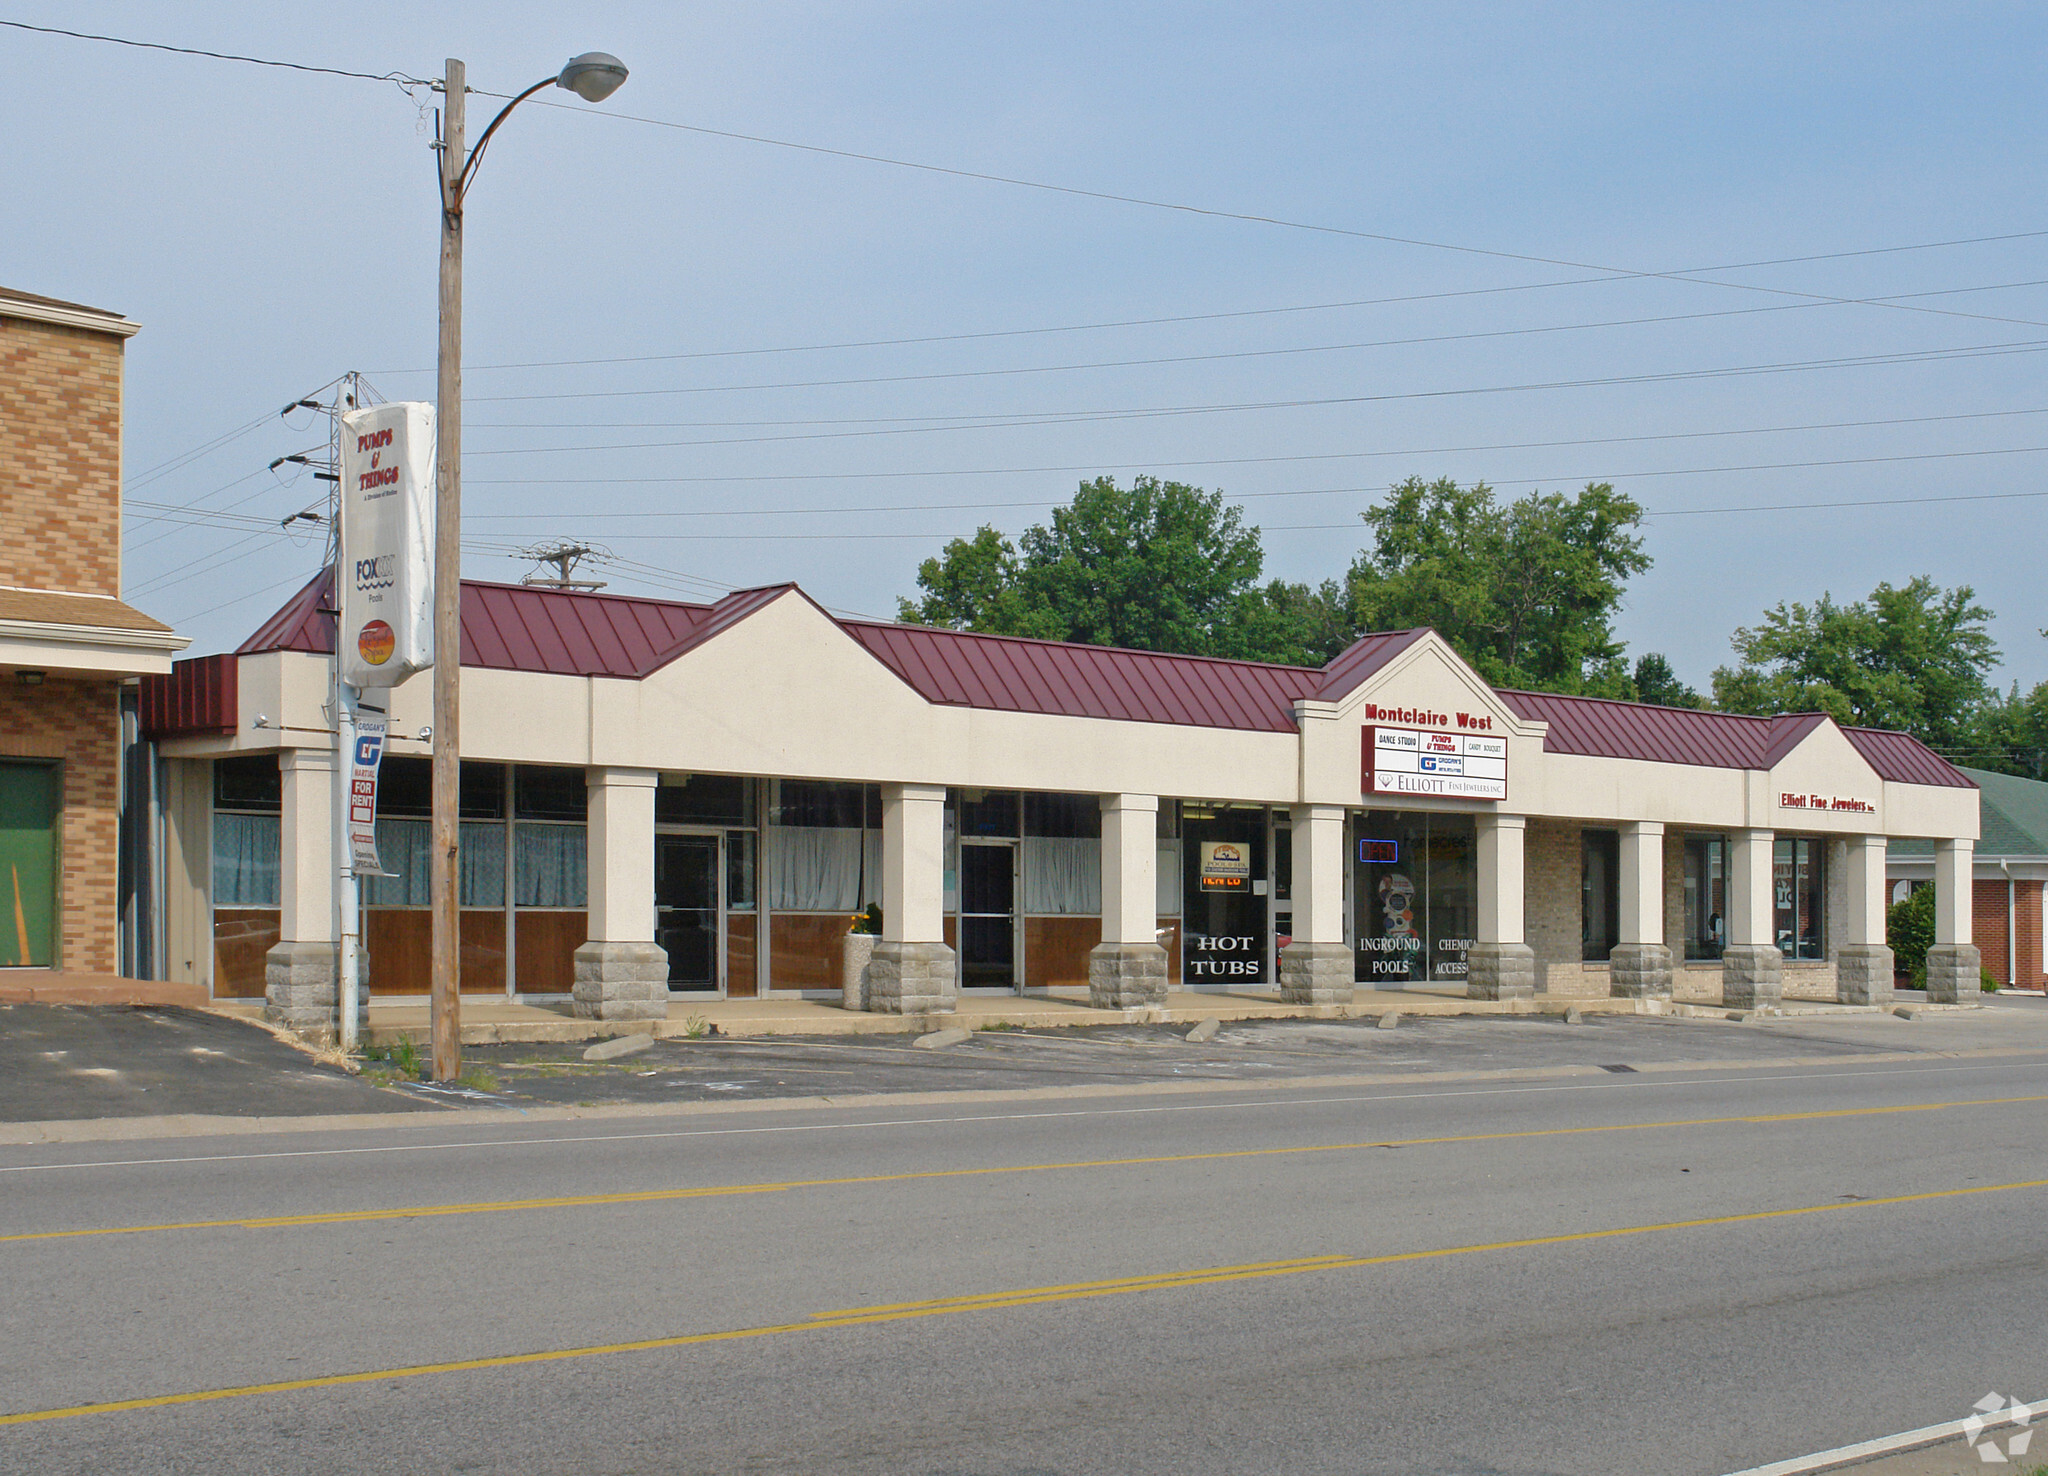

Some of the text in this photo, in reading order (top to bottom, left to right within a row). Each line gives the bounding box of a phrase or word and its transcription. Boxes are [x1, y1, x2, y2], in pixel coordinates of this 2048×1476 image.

[357, 428, 393, 453] PUMPS
[358, 466, 399, 491] THINGS
[368, 593, 384, 604] Pools
[1365, 703, 1492, 730] Montclaire West
[1379, 734, 1417, 746] DANCE STUDIO
[1431, 734, 1451, 744] PUMPS
[1433, 742, 1456, 752] THINGS
[1468, 743, 1502, 753] CANDY BOUQUET
[354, 769, 374, 778] MARTIAL
[354, 781, 373, 794] FOR
[1398, 775, 1502, 794] ELLIOTT FINE JEWELERS INC
[351, 794, 374, 807] RENT
[1781, 792, 1806, 807] Elliott
[1810, 794, 1828, 809] Fine
[1831, 796, 1866, 812] Jewelers
[1362, 842, 1396, 860] OPEN
[1198, 936, 1254, 951] HOT
[1360, 938, 1420, 951] INGROUND
[1460, 950, 1467, 961] &
[1190, 960, 1259, 975] TUBS
[1372, 960, 1469, 974] POOLS ACCESS
